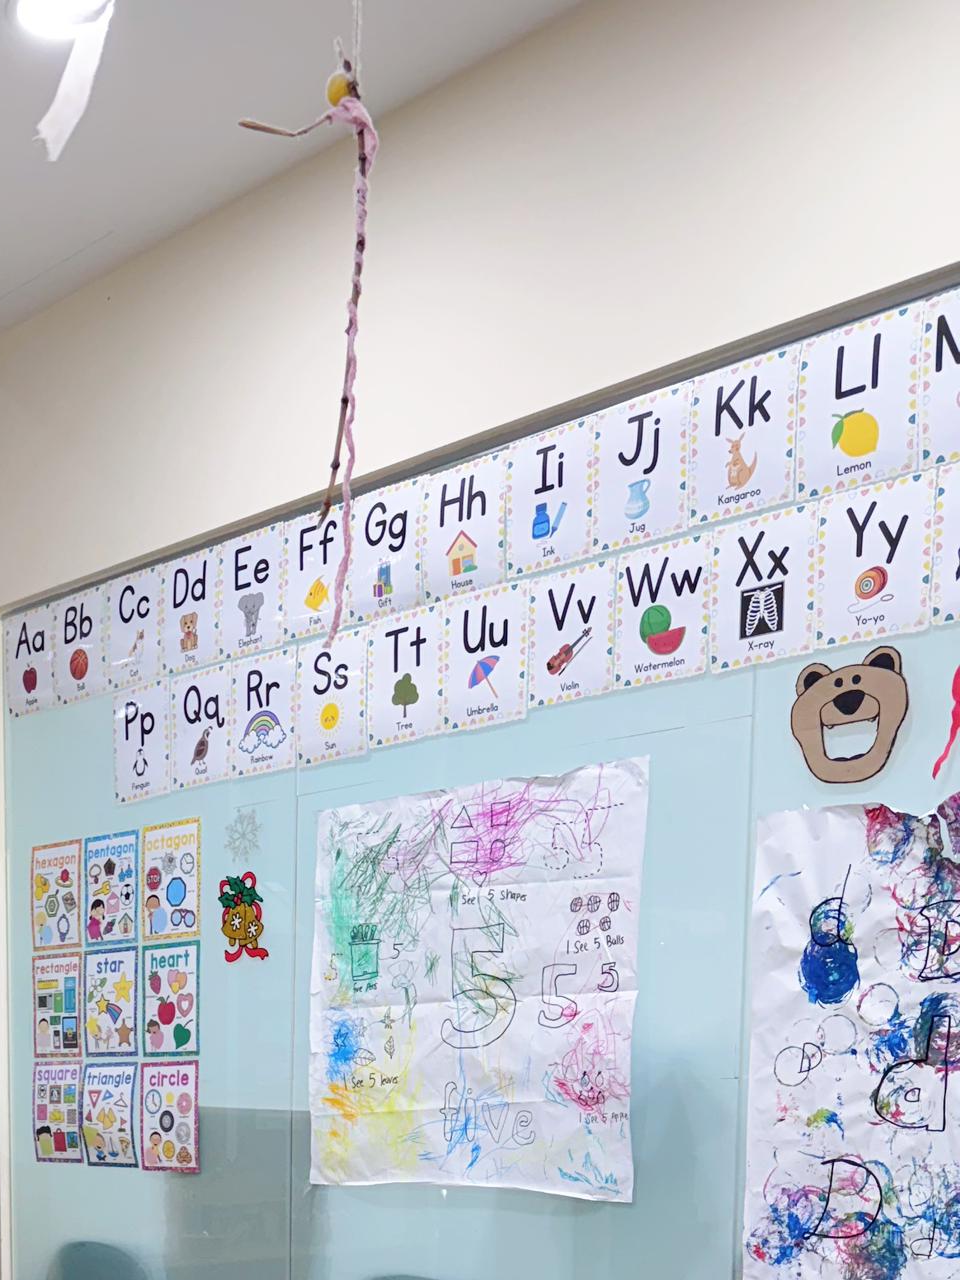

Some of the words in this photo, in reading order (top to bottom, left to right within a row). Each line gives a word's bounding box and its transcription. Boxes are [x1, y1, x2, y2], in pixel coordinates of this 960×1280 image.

[835, 333, 882, 400] Ll
[715, 376, 772, 436] Kk
[618, 411, 662, 475] Jj
[534, 444, 566, 495] Ii
[836, 459, 872, 477] Lemon
[439, 475, 487, 527] Hh
[717, 487, 761, 506] Kangaroo
[365, 502, 408, 552] Gg
[628, 522, 646, 534] Jug
[846, 501, 909, 564] Yy
[299, 520, 338, 571] Ff
[542, 546, 555, 557] Ink
[234, 546, 270, 591] Ee
[736, 531, 790, 587] Xx
[172, 560, 207, 609] Dd
[451, 578, 473, 590] House
[625, 556, 702, 607] Ww
[119, 585, 150, 624] Cc
[378, 597, 392, 608] Gift
[548, 583, 596, 631] Vv
[64, 602, 93, 645] Bb
[308, 615, 322, 626] Fish
[463, 605, 509, 654] Uu
[855, 612, 885, 627] Yo-yo
[15, 621, 45, 659] Aa
[238, 635, 263, 648] Elephant
[385, 626, 427, 673] Tt
[747, 638, 775, 652] X-ray
[313, 651, 349, 695] Ss
[634, 656, 686, 675] Watermelon
[246, 670, 280, 712] Rr
[560, 681, 580, 692] Violin
[183, 685, 225, 728] Qq
[466, 703, 499, 717] Umbrella
[125, 701, 155, 746] Pp
[396, 720, 413, 731] Tree
[324, 741, 337, 751] Sun
[250, 754, 274, 765] Rainbow
[88, 841, 135, 860] pentagon
[145, 832, 196, 853] octagon
[35, 853, 77, 870] hexagon
[462, 894, 477, 905] See
[488, 889, 495, 901] 5
[574, 940, 588, 954] See
[594, 937, 601, 950] 5
[606, 934, 625, 947] Balls
[35, 960, 78, 976] rectangle
[96, 958, 125, 975] star
[150, 951, 191, 969] heart
[440, 922, 517, 1049] 5
[597, 961, 620, 993] 5
[538, 963, 578, 1028] 5
[36, 1067, 78, 1085] square
[87, 1070, 132, 1088] triangle
[149, 1070, 190, 1087] circle
[351, 1075, 364, 1088] See
[369, 1072, 376, 1088] 5
[440, 1081, 536, 1145] five
[585, 1113, 598, 1124] See
